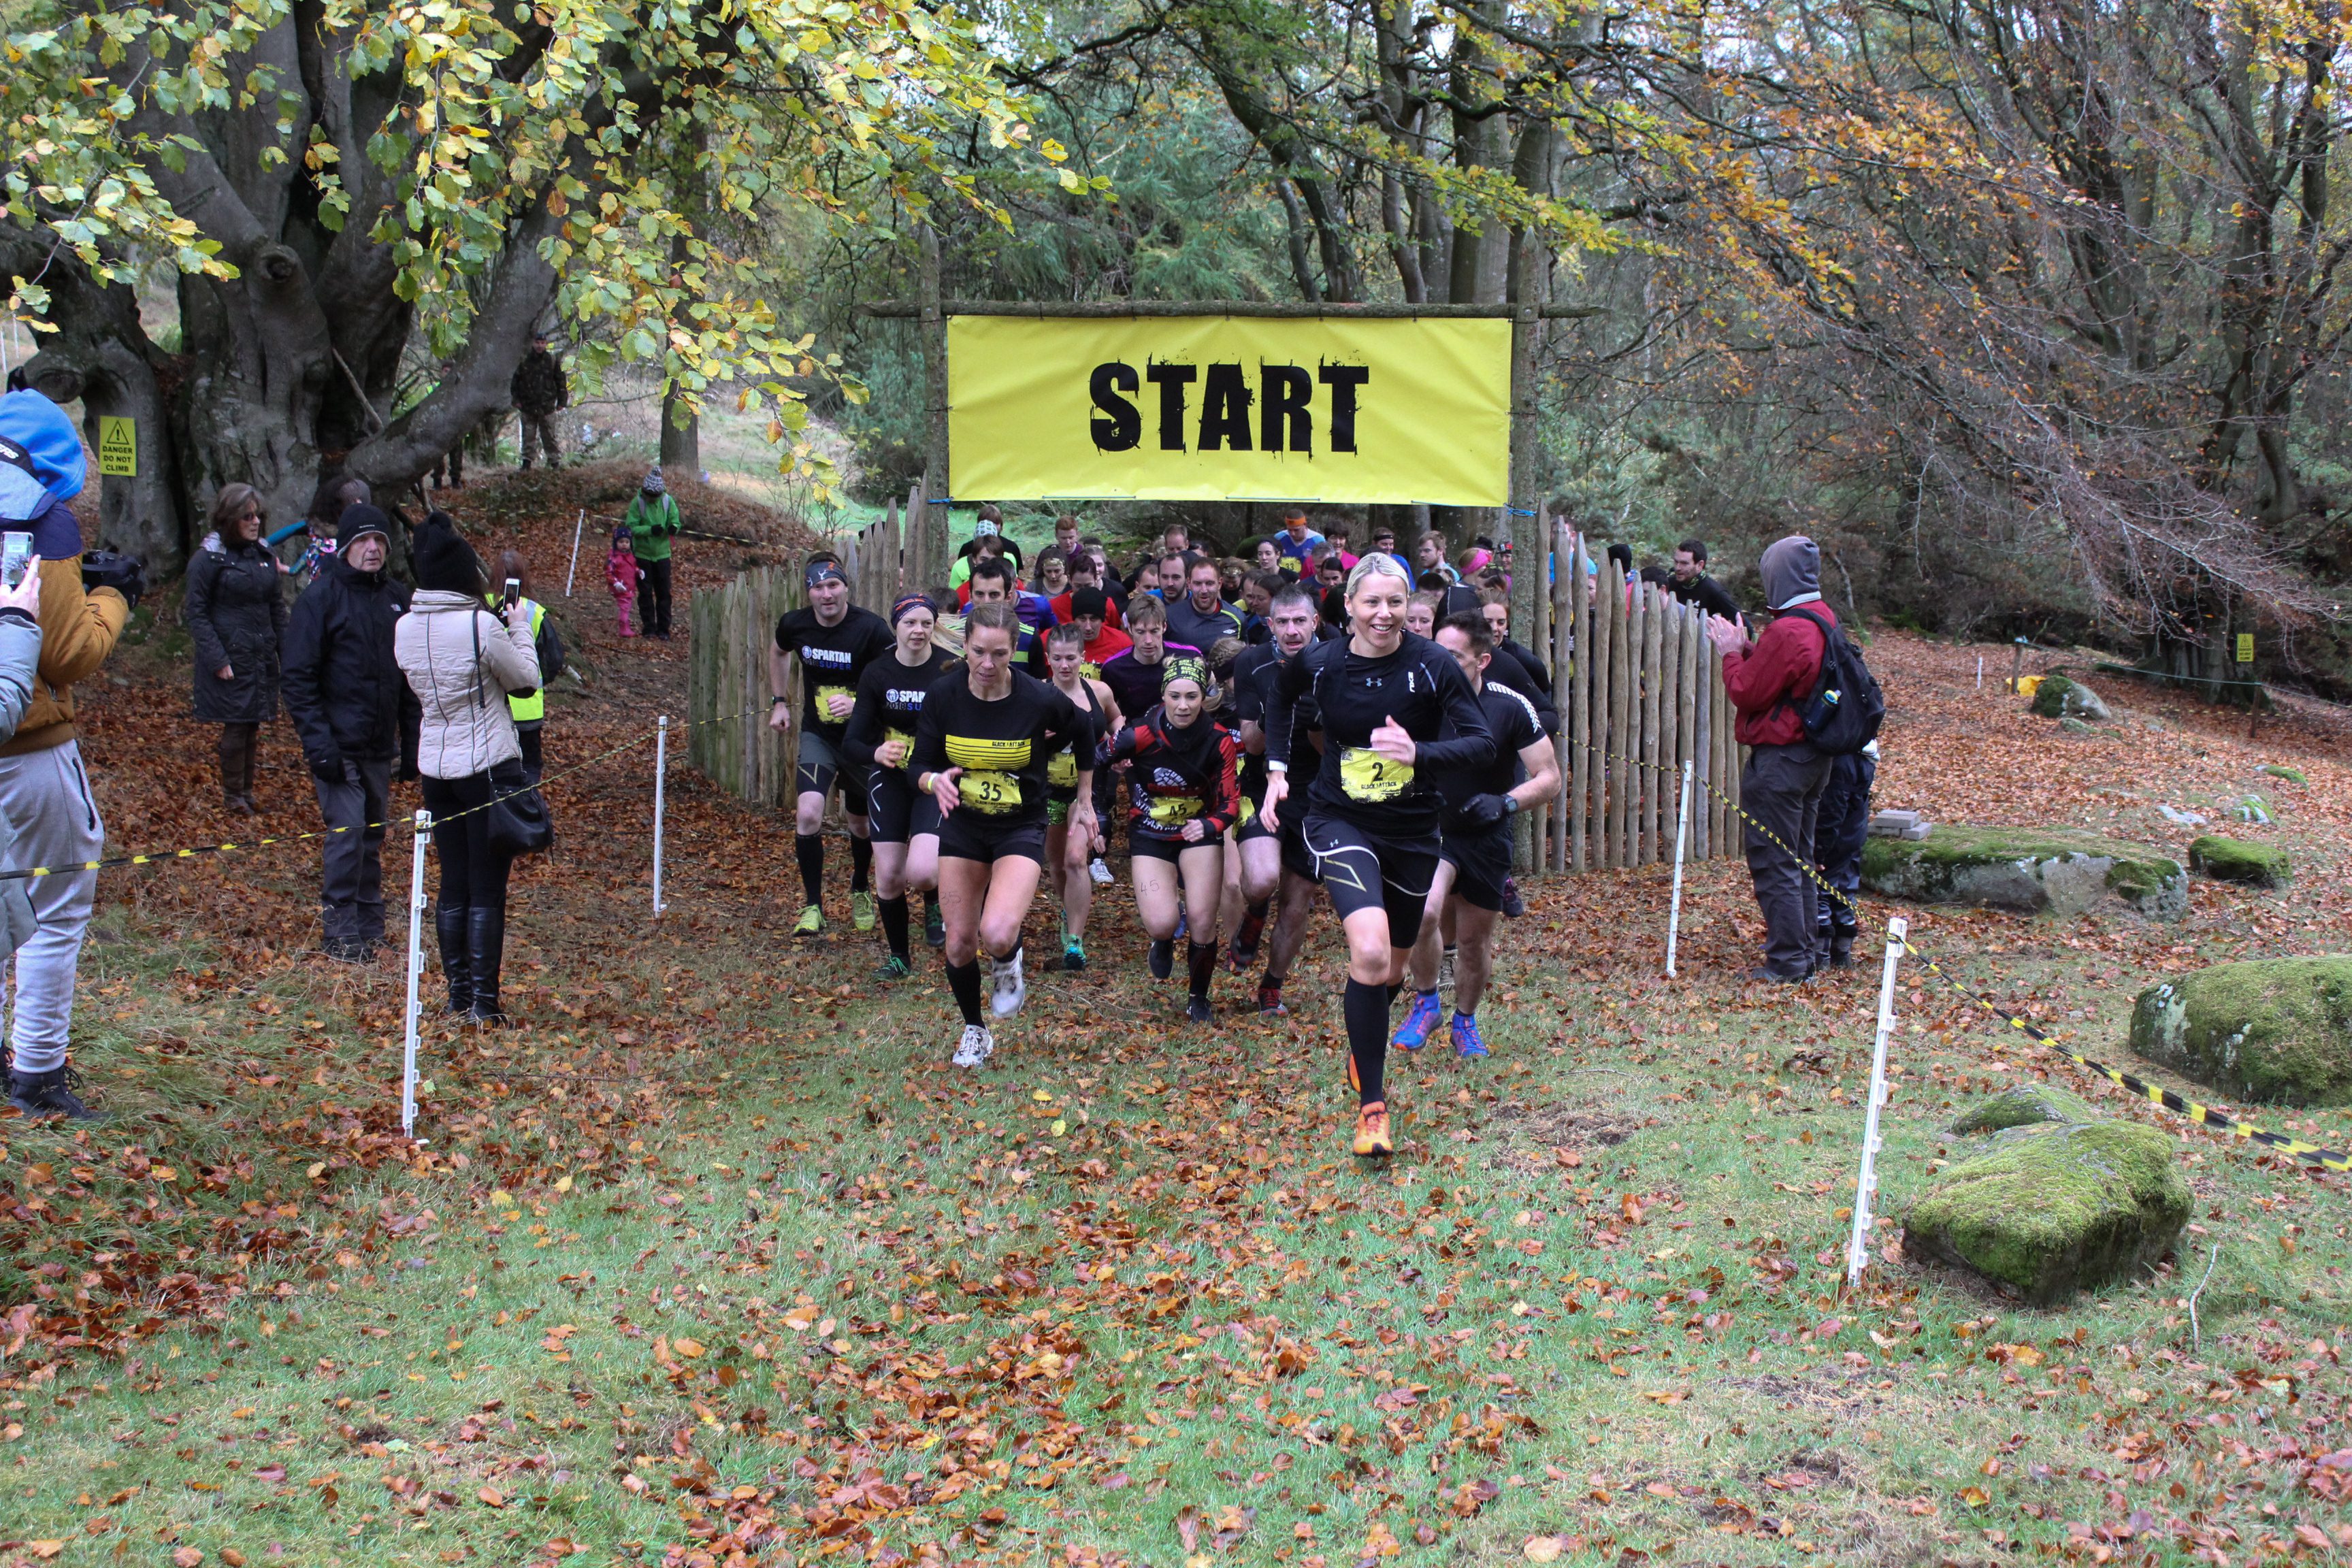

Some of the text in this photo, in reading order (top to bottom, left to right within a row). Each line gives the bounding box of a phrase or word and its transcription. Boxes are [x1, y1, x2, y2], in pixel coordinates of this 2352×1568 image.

[1089, 351, 1369, 460] START
[103, 446, 133, 454] DANGER
[812, 648, 851, 664] SPARTAN
[819, 660, 852, 670] SUPER
[1372, 762, 1384, 782] 2
[979, 781, 1002, 802] 35
[1169, 803, 1187, 817] 45
[1141, 879, 1160, 897] 45
